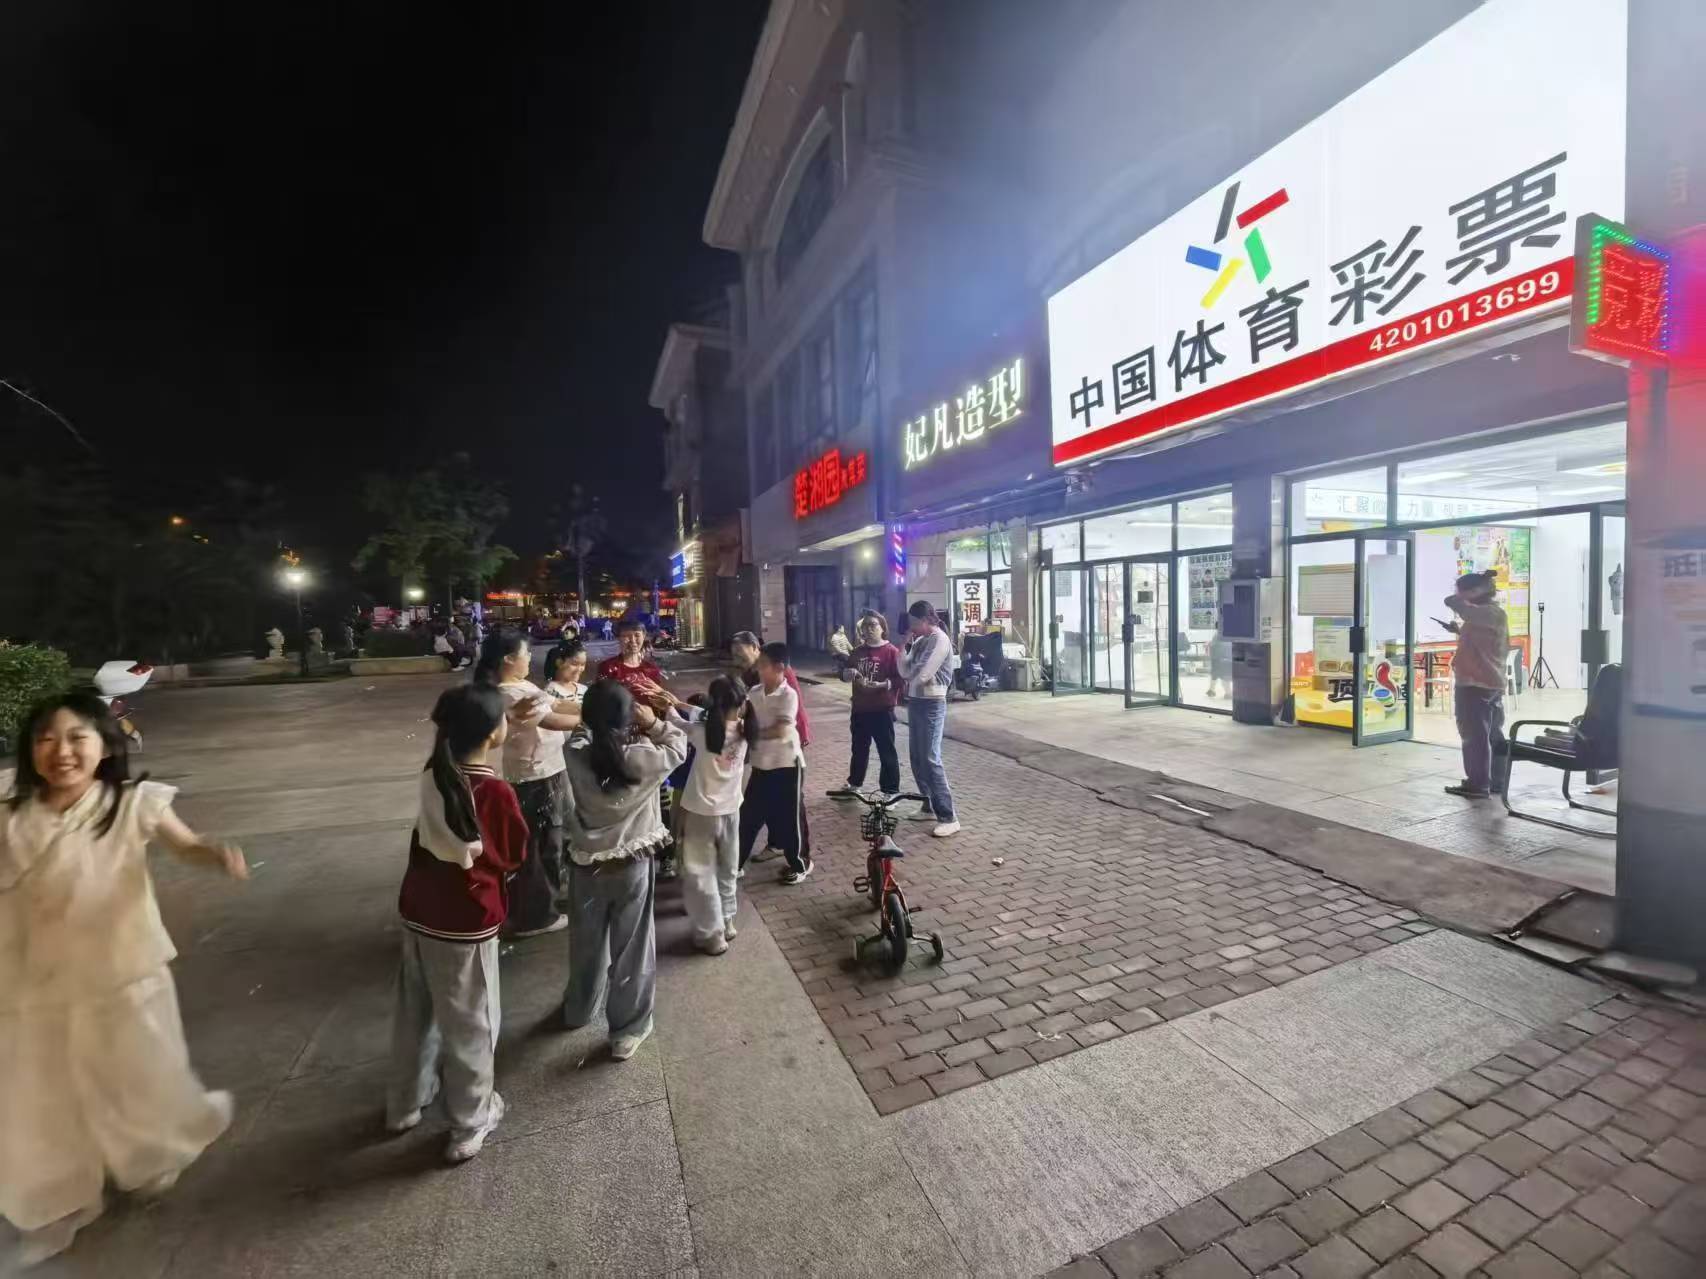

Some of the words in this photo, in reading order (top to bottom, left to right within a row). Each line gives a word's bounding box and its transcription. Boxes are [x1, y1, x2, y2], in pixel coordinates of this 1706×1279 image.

[1069, 151, 1568, 428] 中国体育彩票
[1368, 271, 1561, 353] 4201013699
[904, 358, 1024, 471] 妃凡造型
